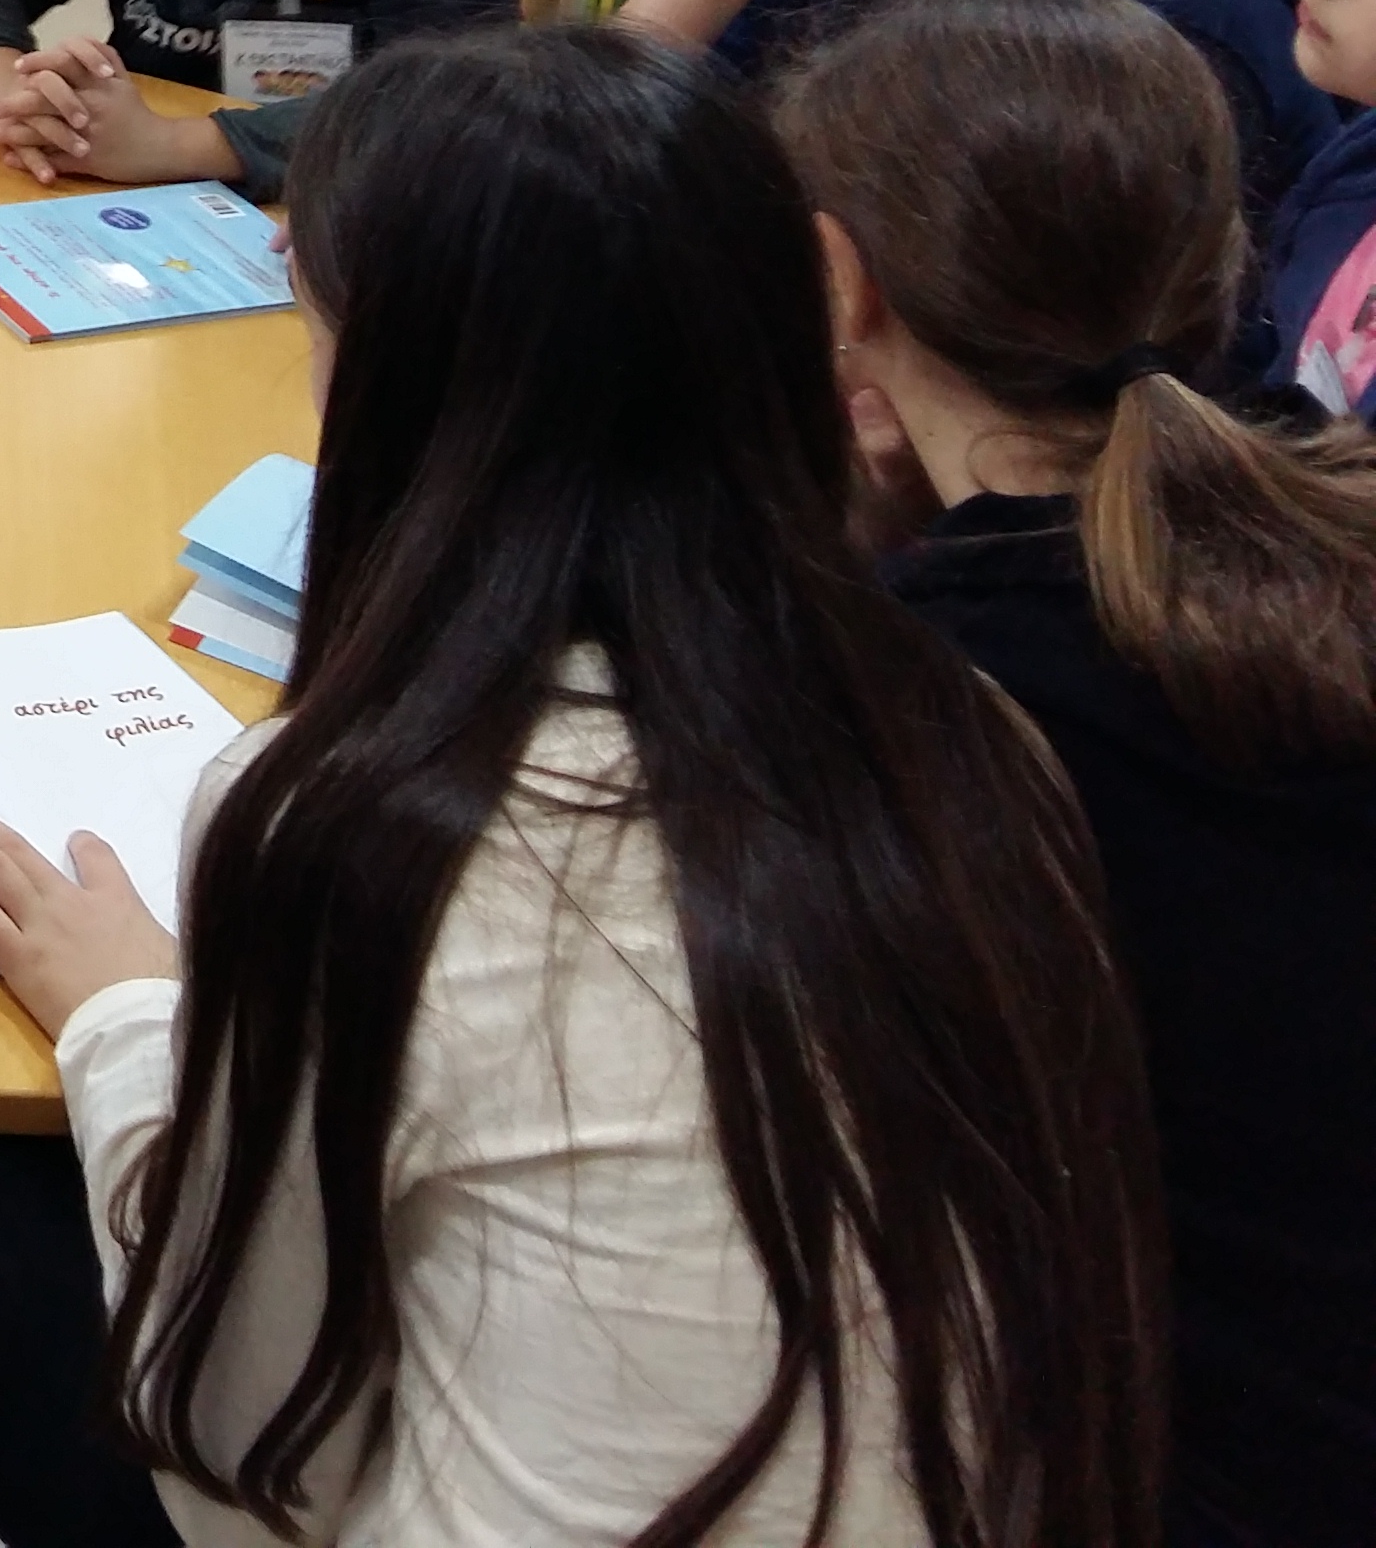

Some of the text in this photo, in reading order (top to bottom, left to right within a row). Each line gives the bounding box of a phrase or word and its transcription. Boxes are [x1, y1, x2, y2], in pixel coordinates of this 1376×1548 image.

[14, 697, 100, 717] αστέρι
[111, 686, 165, 704] της
[105, 713, 195, 747] φιλίας
